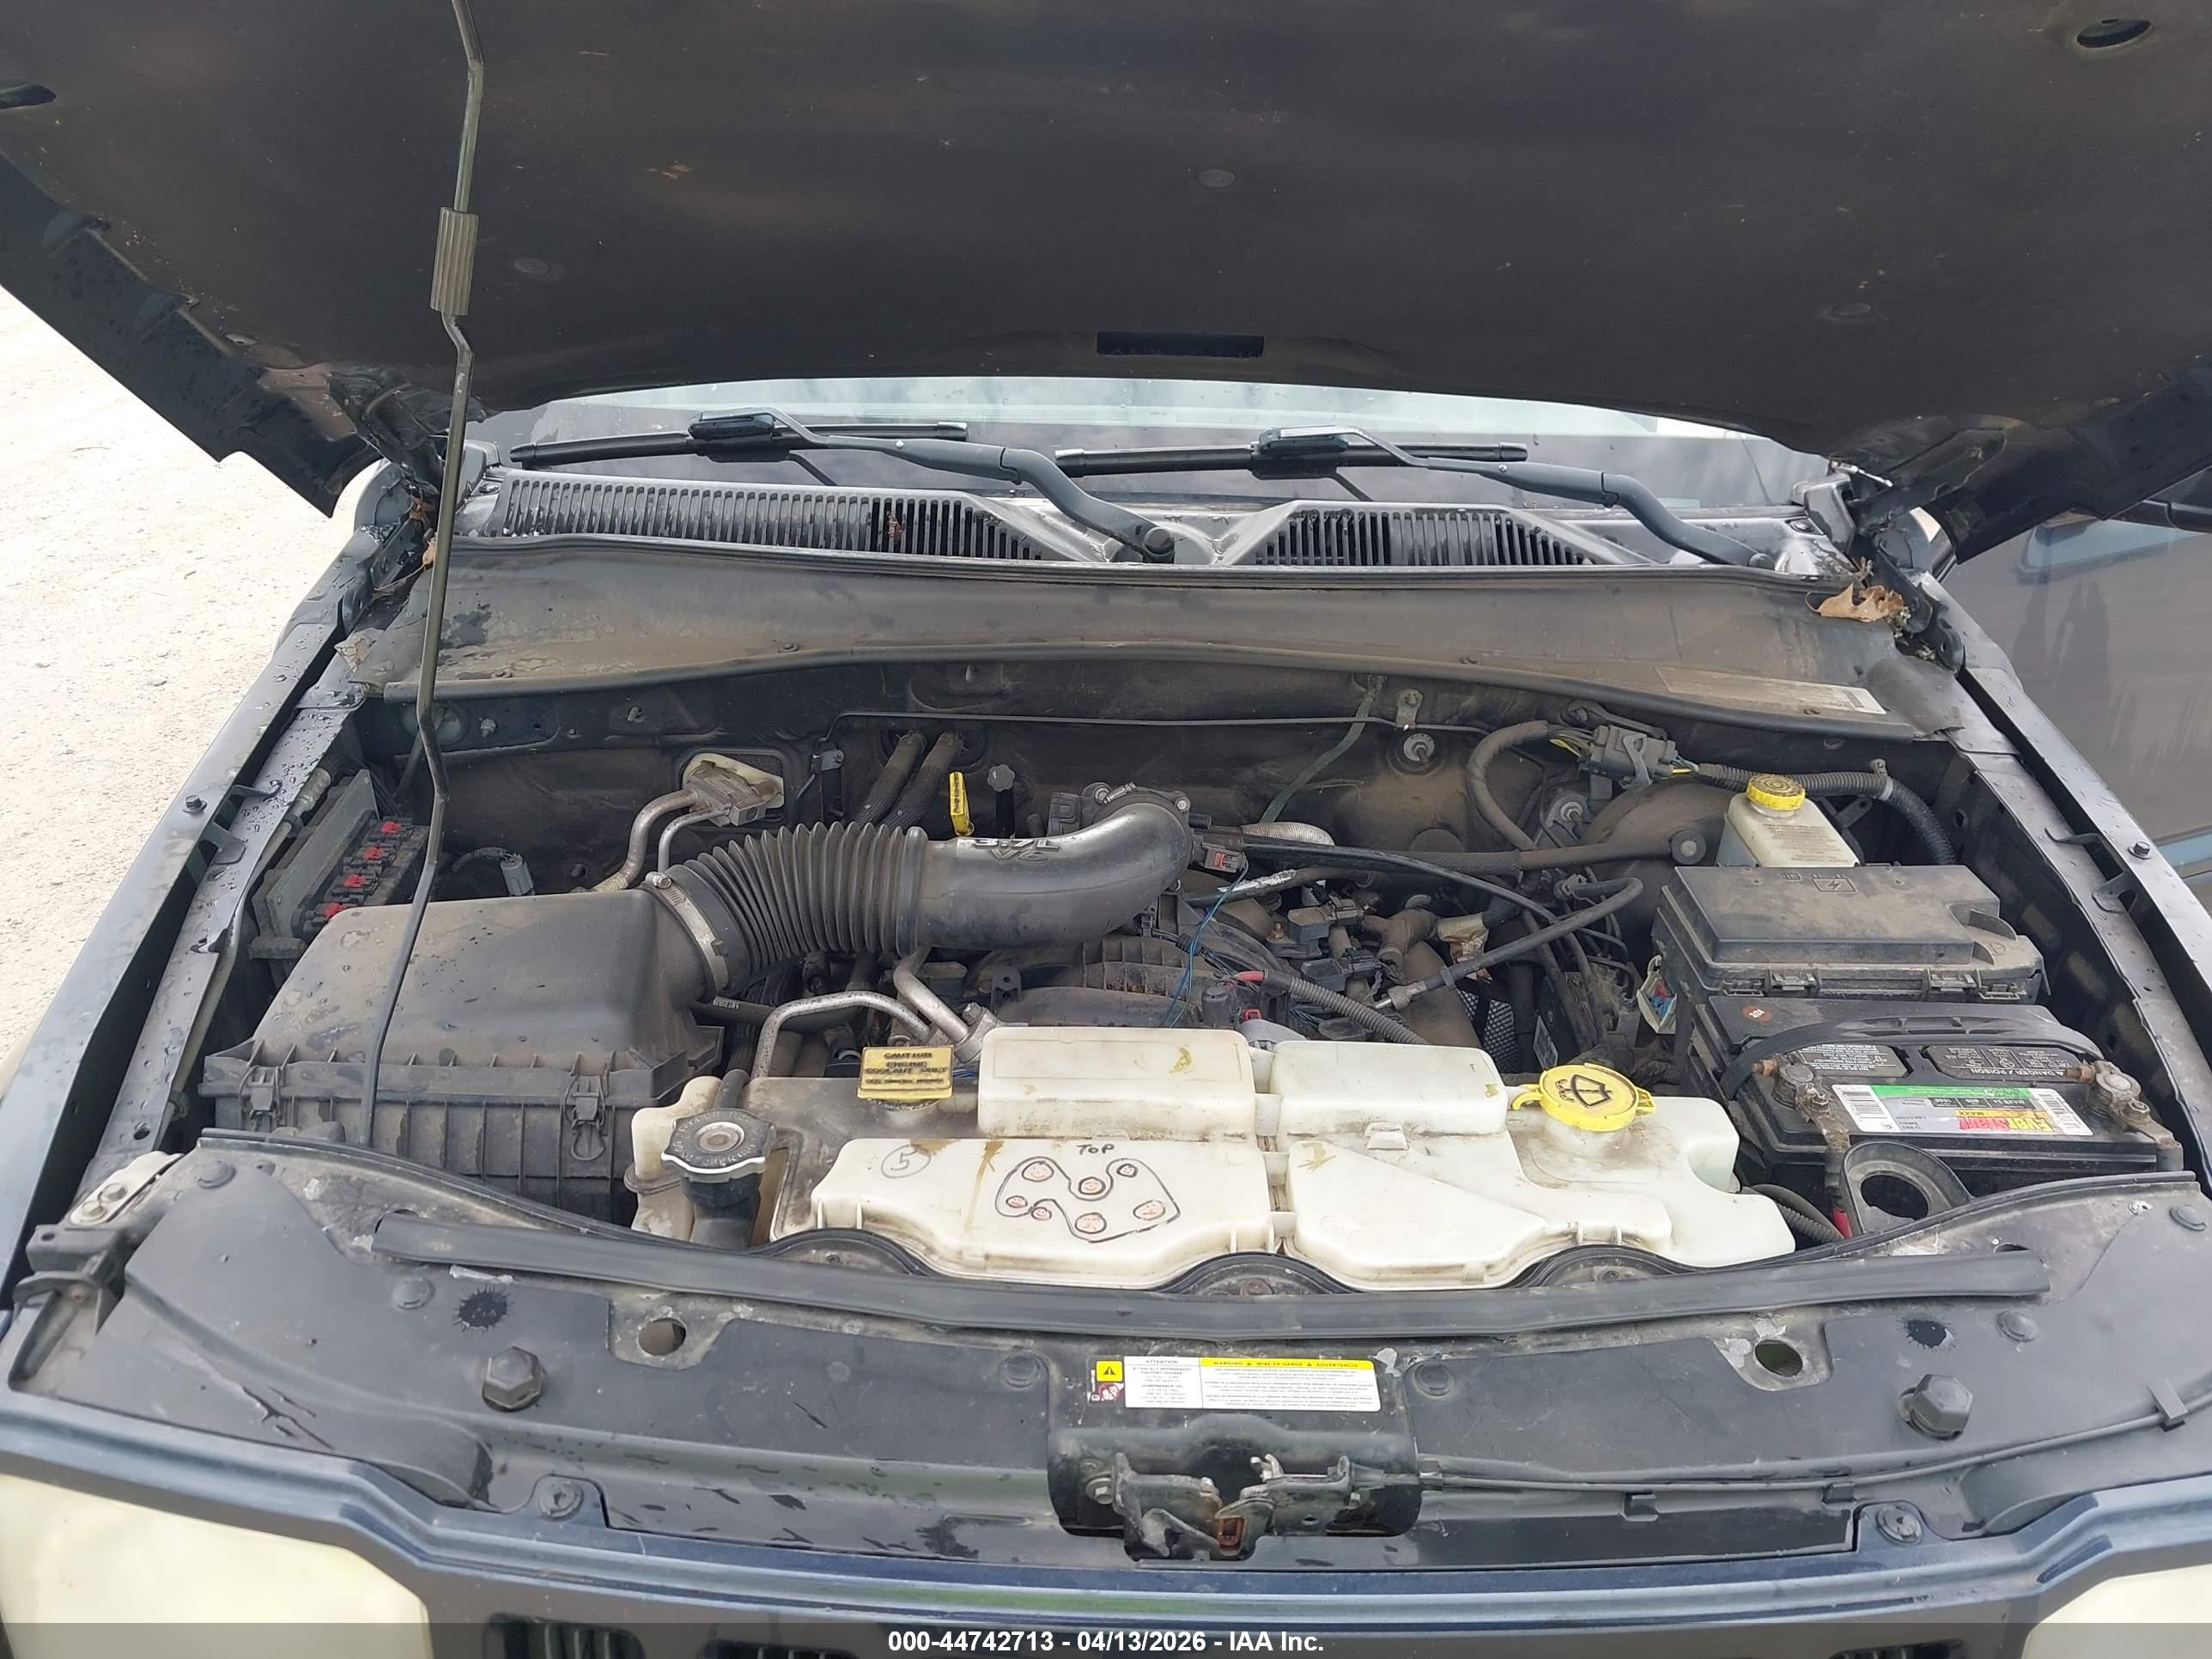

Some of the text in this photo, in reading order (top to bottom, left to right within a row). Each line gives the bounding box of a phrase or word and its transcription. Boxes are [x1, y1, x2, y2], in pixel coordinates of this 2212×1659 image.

[975, 838, 1060, 851] 3.7L
[989, 848, 1047, 861] V6
[1956, 1116, 2055, 1133] EverStart
[890, 1152, 910, 1171] 5
